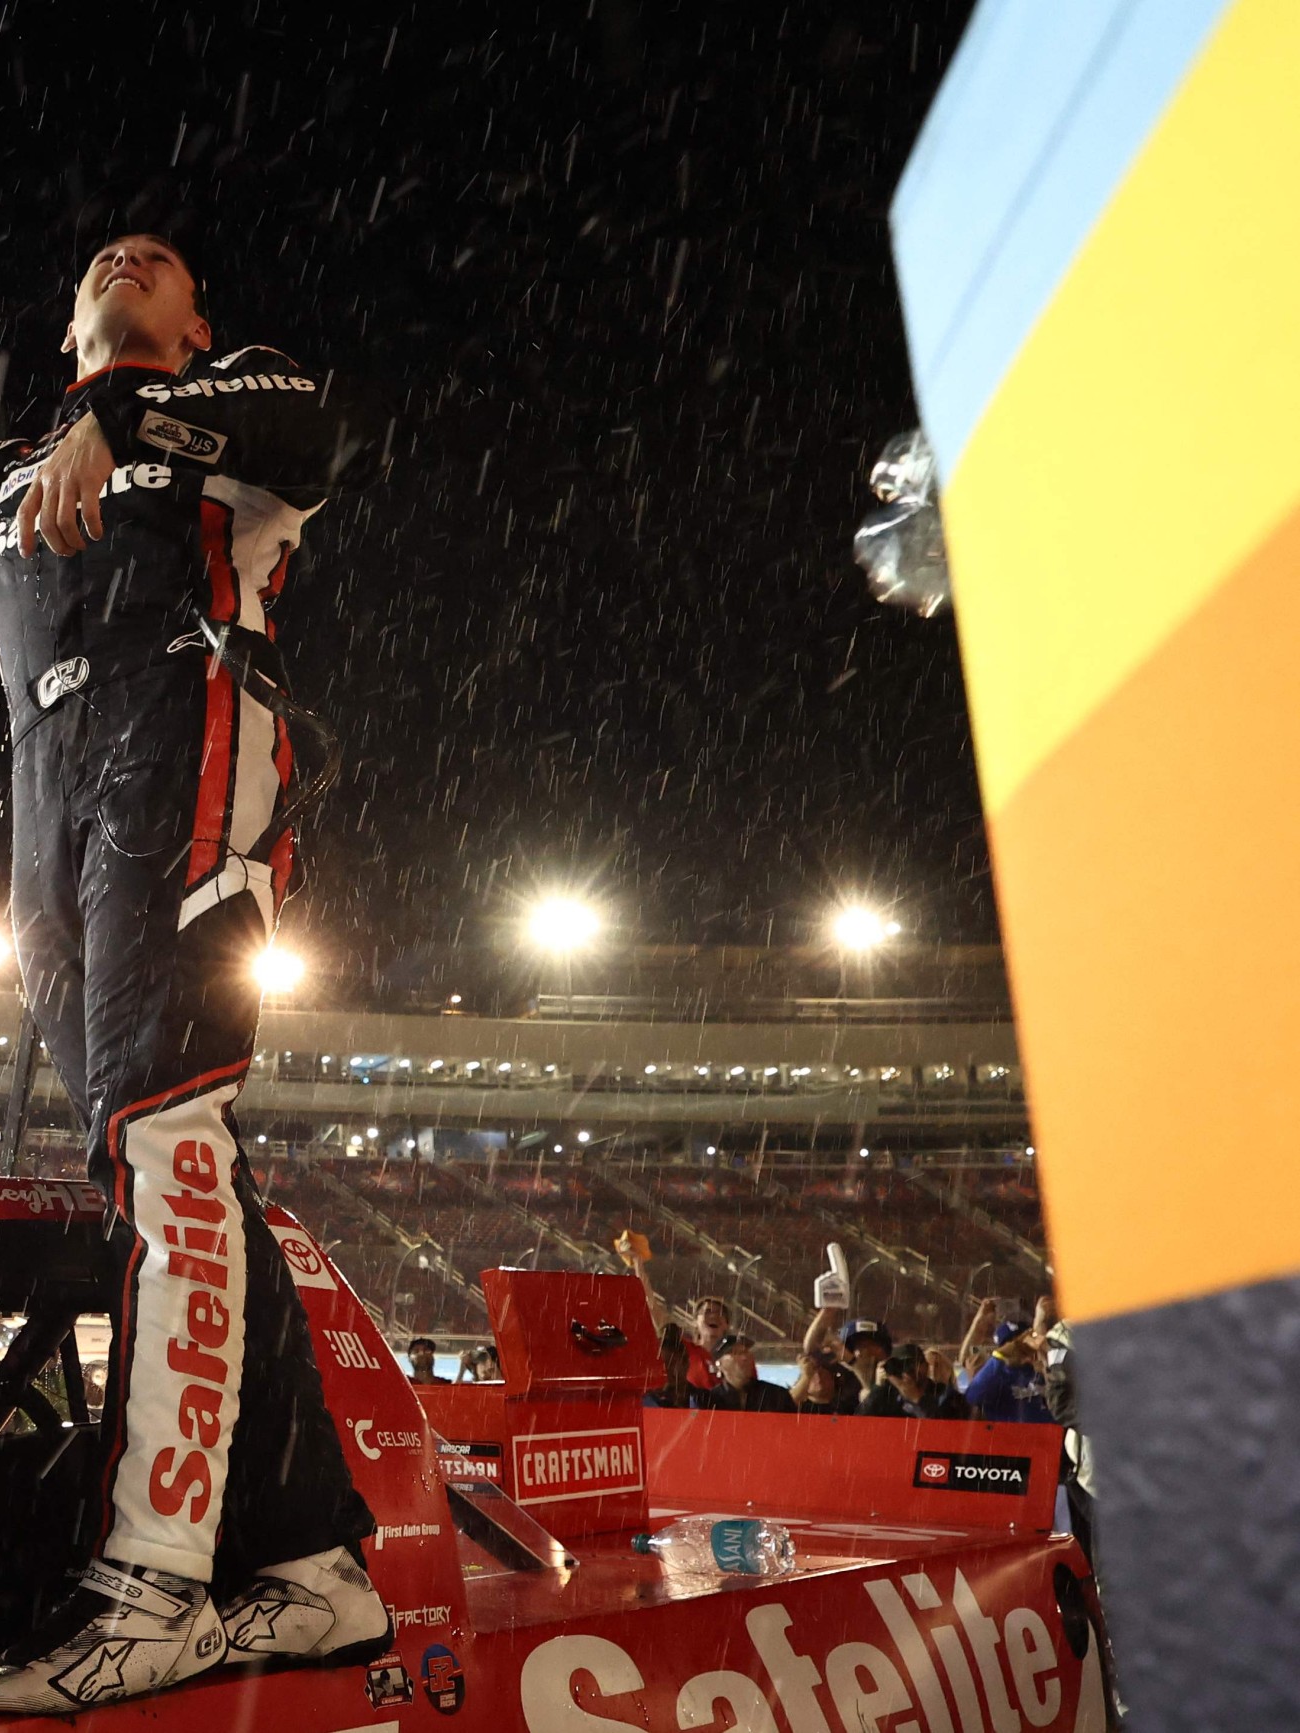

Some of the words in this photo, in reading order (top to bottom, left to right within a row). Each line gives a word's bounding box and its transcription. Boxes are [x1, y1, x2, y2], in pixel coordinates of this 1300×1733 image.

[136, 374, 316, 403] Safelite
[2, 468, 35, 497] Mobil
[33, 1184, 107, 1212] HE
[148, 1140, 231, 1524] Safelite
[328, 1330, 381, 1370] JBL
[376, 1431, 422, 1448] CELSIUS
[440, 1444, 471, 1455] NASCAR
[439, 1460, 498, 1478] TSMAN
[522, 1444, 635, 1487] CRAFTSMAN
[955, 1466, 1023, 1482] TOYOTA
[384, 1525, 403, 1539] First
[403, 1524, 421, 1537] Auto
[421, 1523, 440, 1536] Group
[718, 1528, 745, 1571] ASANI
[396, 1605, 452, 1630] FACTORY
